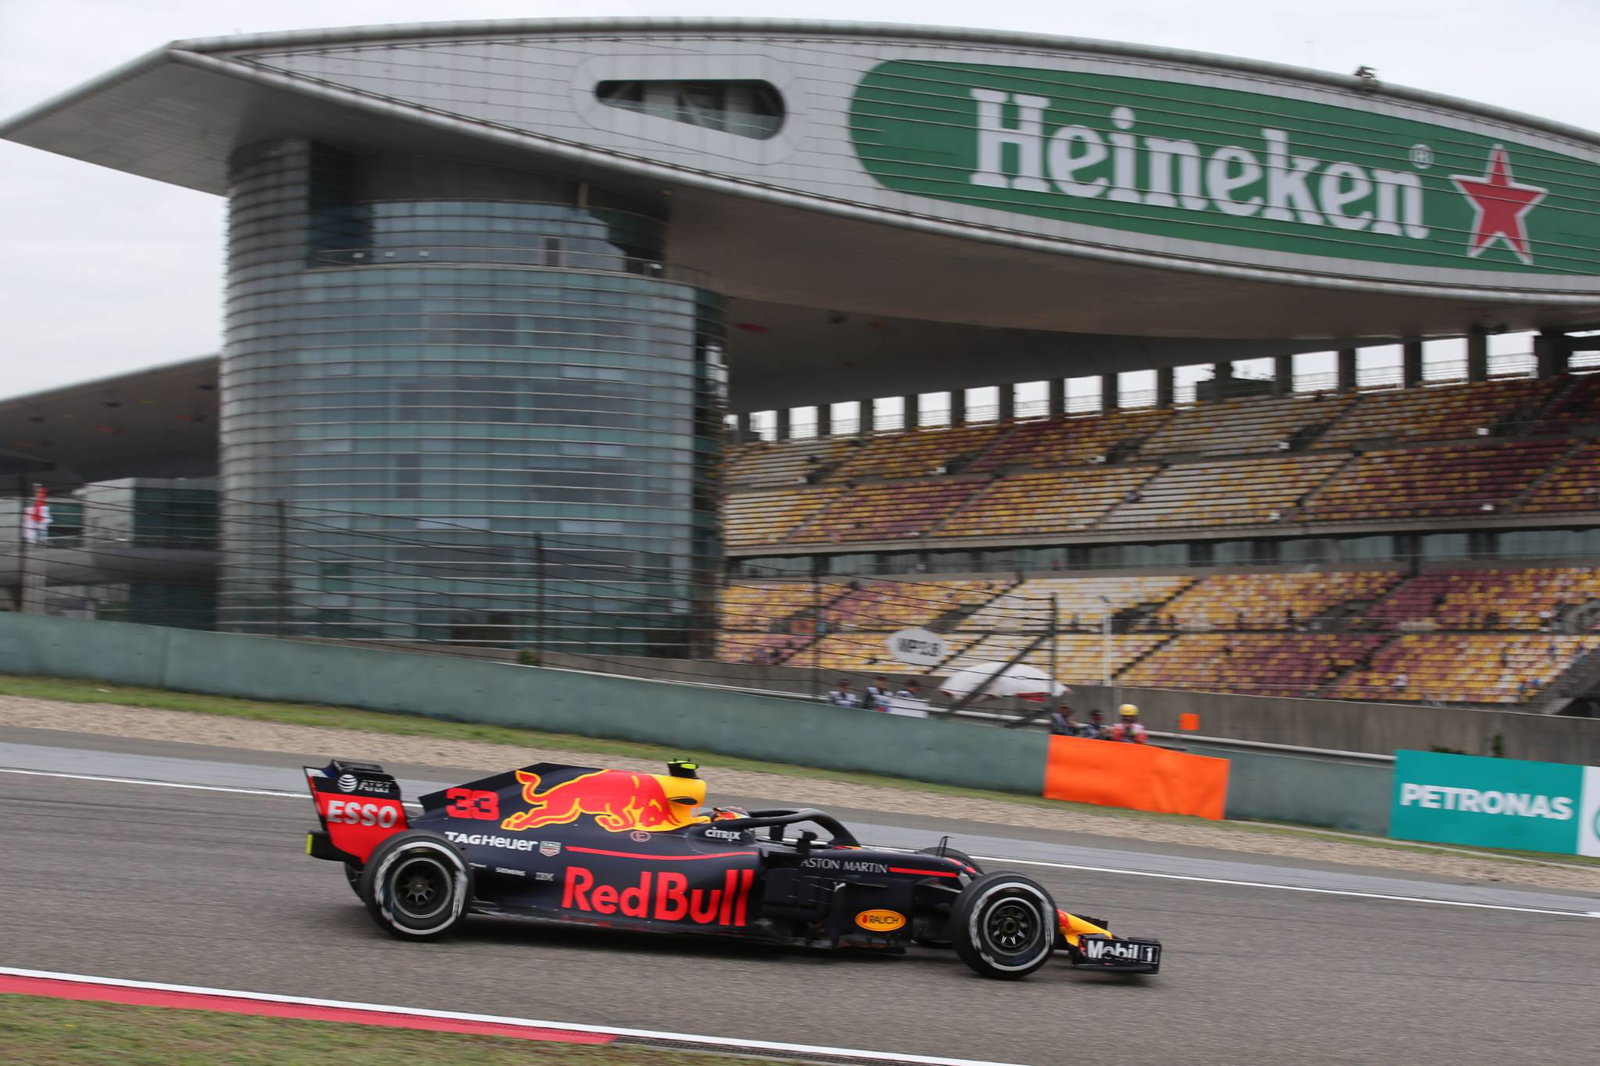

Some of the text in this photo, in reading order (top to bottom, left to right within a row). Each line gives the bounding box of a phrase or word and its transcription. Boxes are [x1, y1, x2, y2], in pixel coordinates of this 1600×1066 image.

[970, 88, 1430, 240] Heineken
[327, 799, 399, 829] ESSO
[445, 787, 500, 821] 33
[1400, 783, 1574, 821] PETRONAS
[801, 857, 889, 874] ASTON MARTIN
[868, 914, 900, 925] RAUCH
[1087, 940, 1154, 962] Mobil 1
